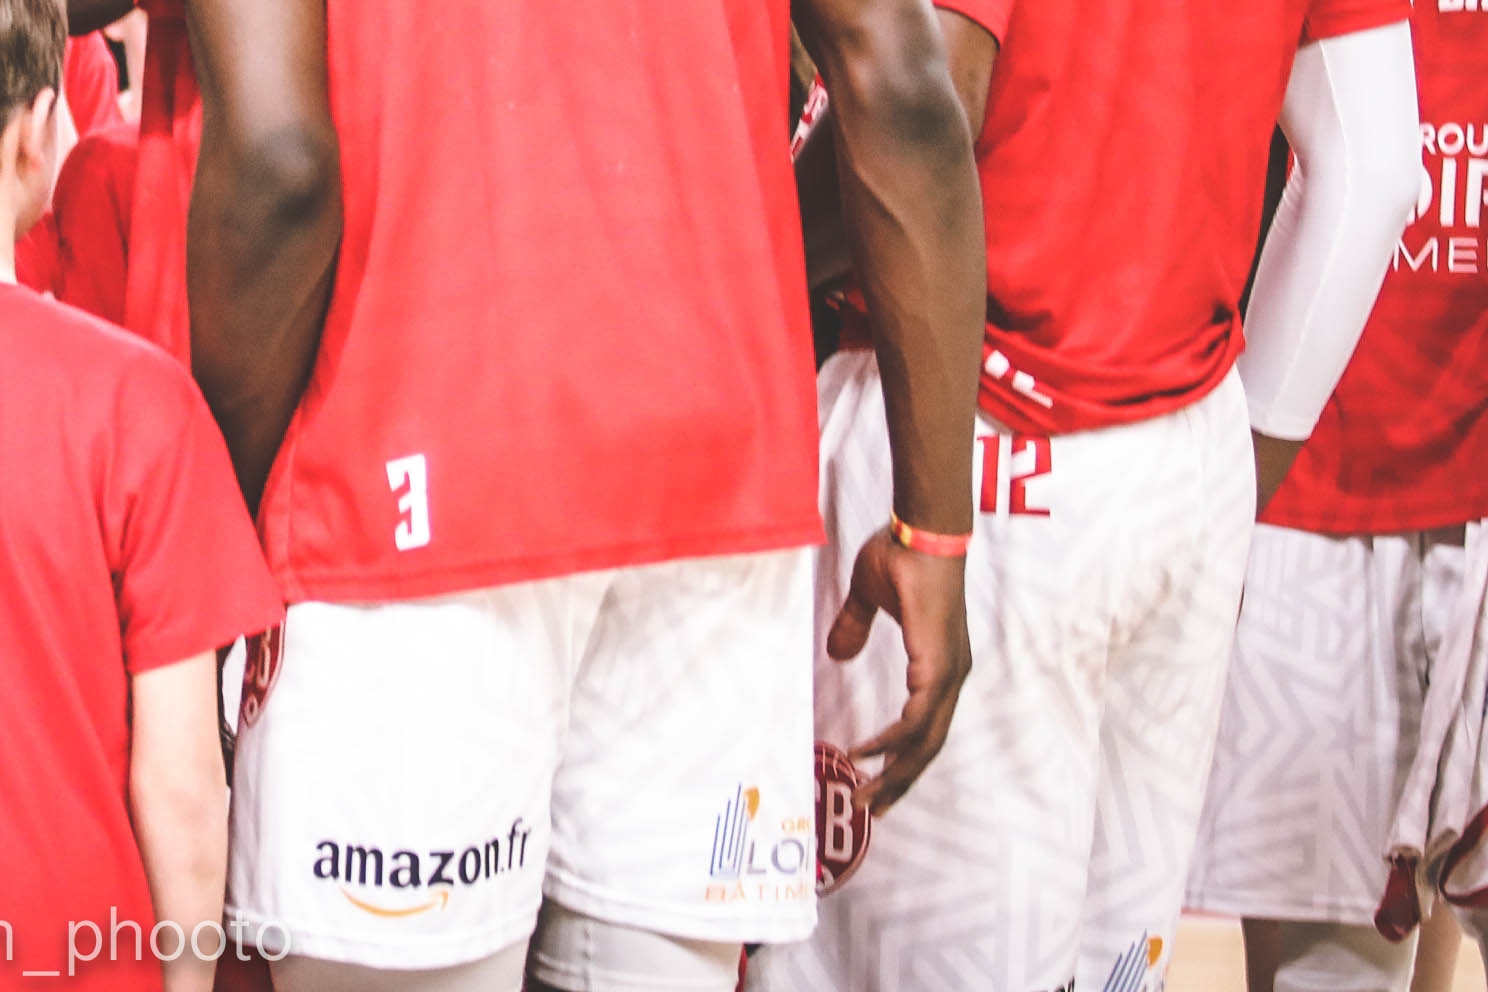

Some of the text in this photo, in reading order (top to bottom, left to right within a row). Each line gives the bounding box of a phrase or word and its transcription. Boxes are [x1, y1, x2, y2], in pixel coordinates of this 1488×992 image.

[1420, 122, 1488, 156] ROU
[1392, 237, 1488, 274] ME
[385, 453, 431, 552] 3
[976, 433, 1053, 517] 12
[313, 816, 532, 889] amazon.fr
[815, 778, 854, 864] B
